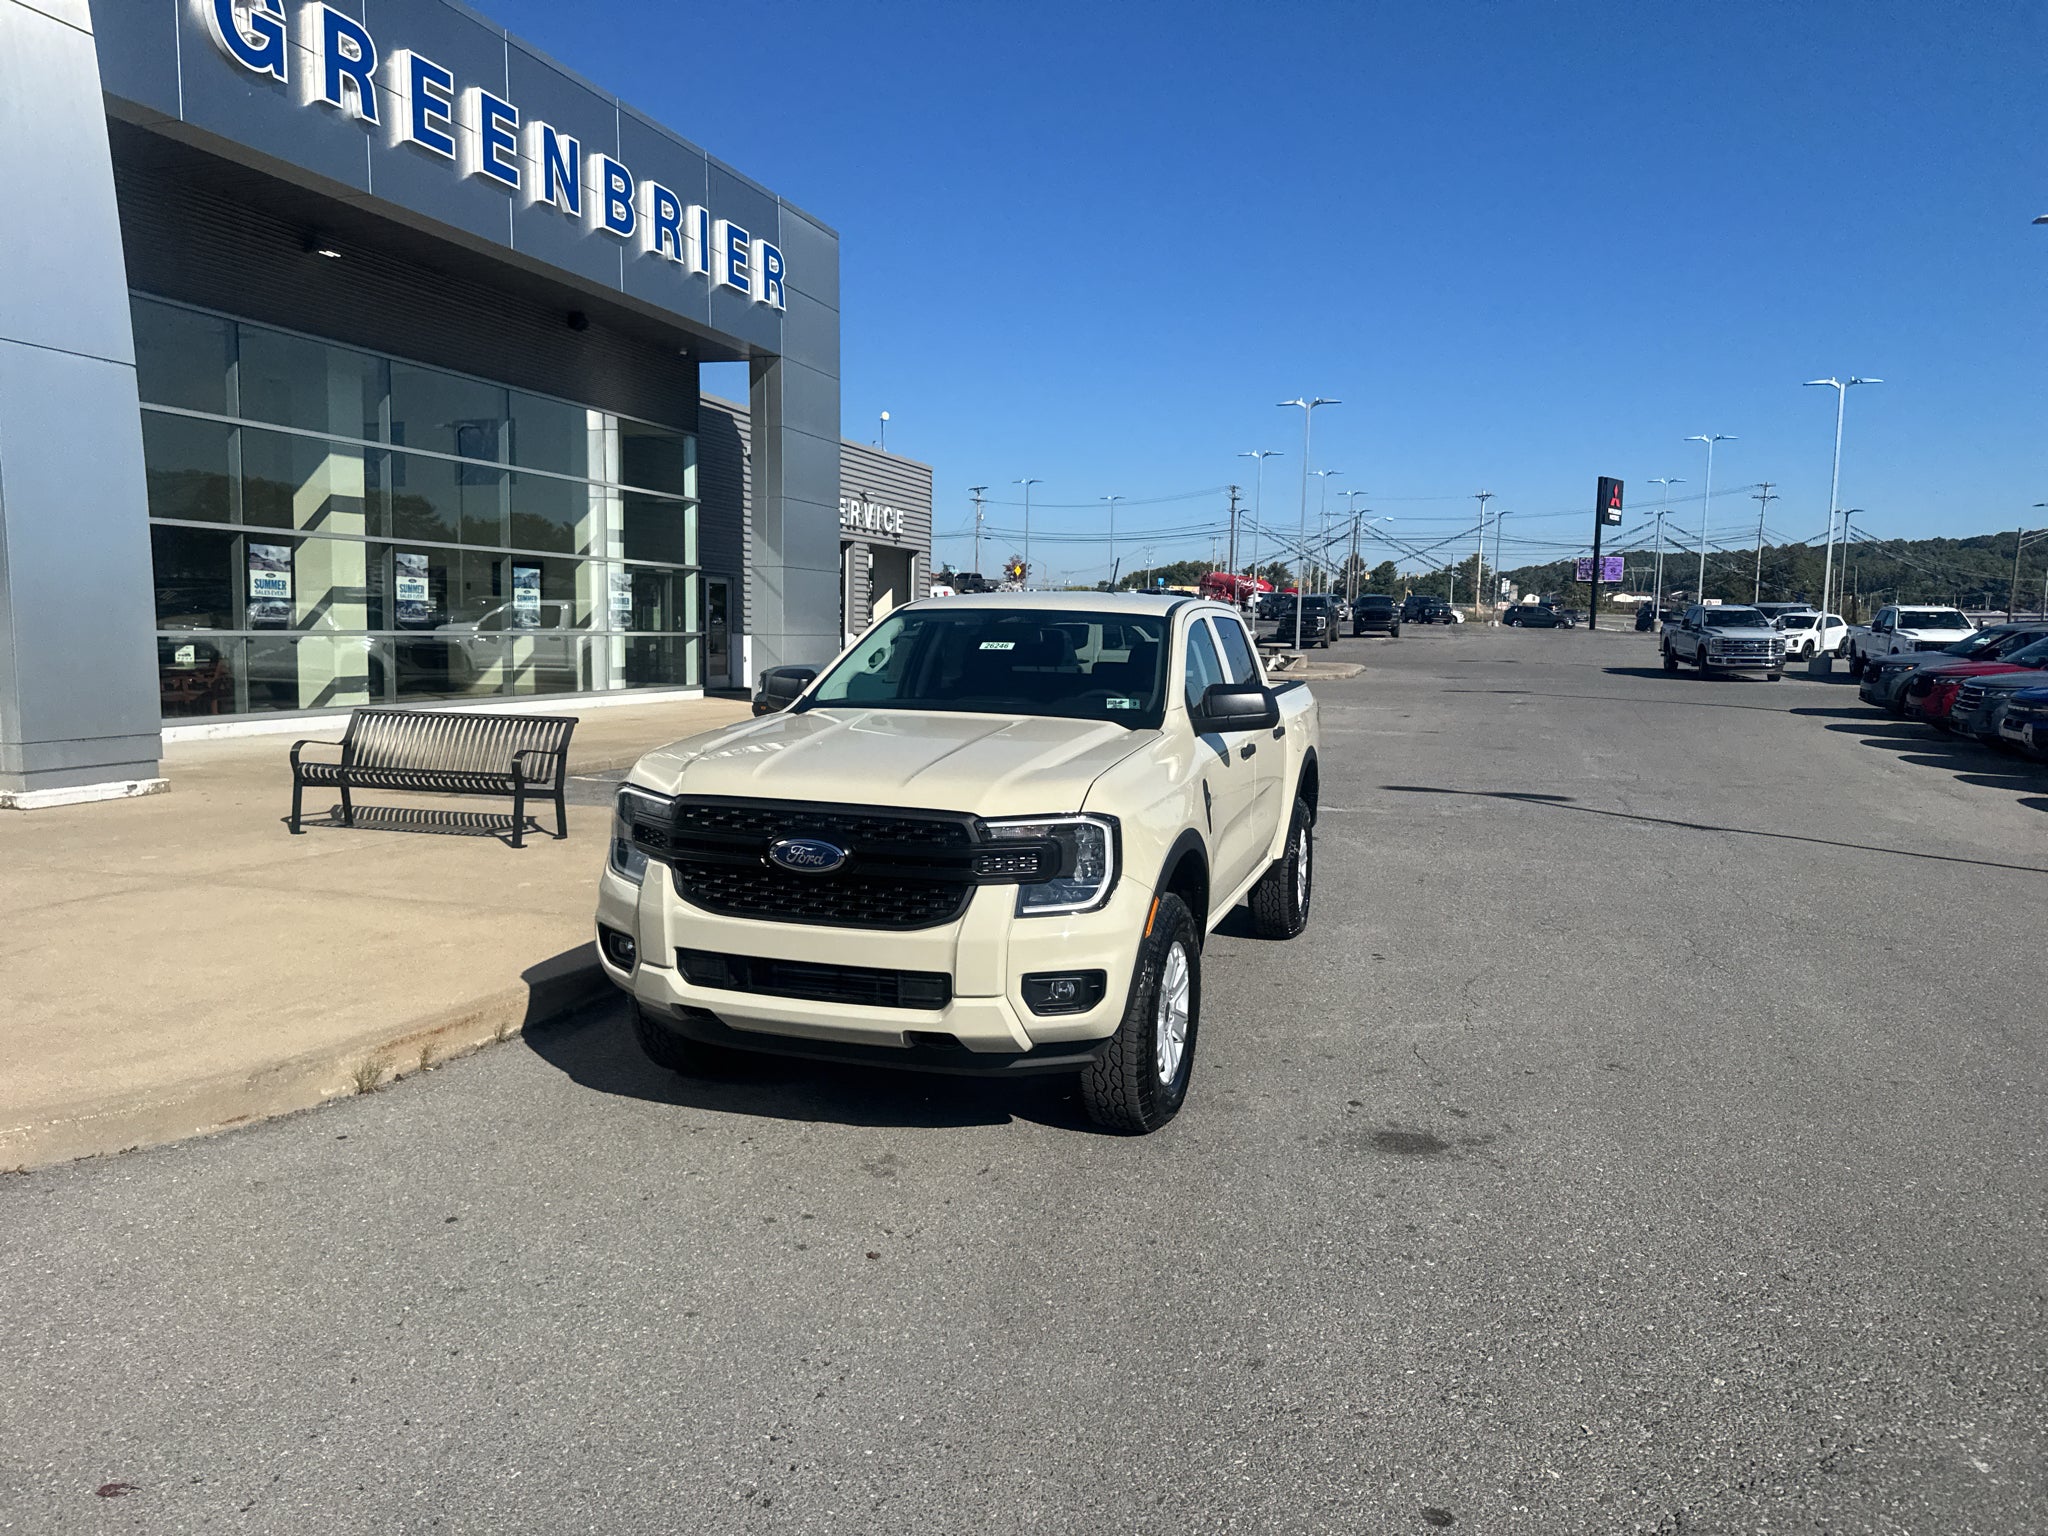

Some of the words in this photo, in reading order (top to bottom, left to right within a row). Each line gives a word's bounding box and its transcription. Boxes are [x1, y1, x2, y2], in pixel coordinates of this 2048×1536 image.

[203, 0, 787, 312] GREENBRIER
[840, 498, 904, 534] ERVICE
[254, 578, 287, 590] SUMMER
[399, 584, 425, 594] SUMMER
[786, 845, 826, 865] Ford
